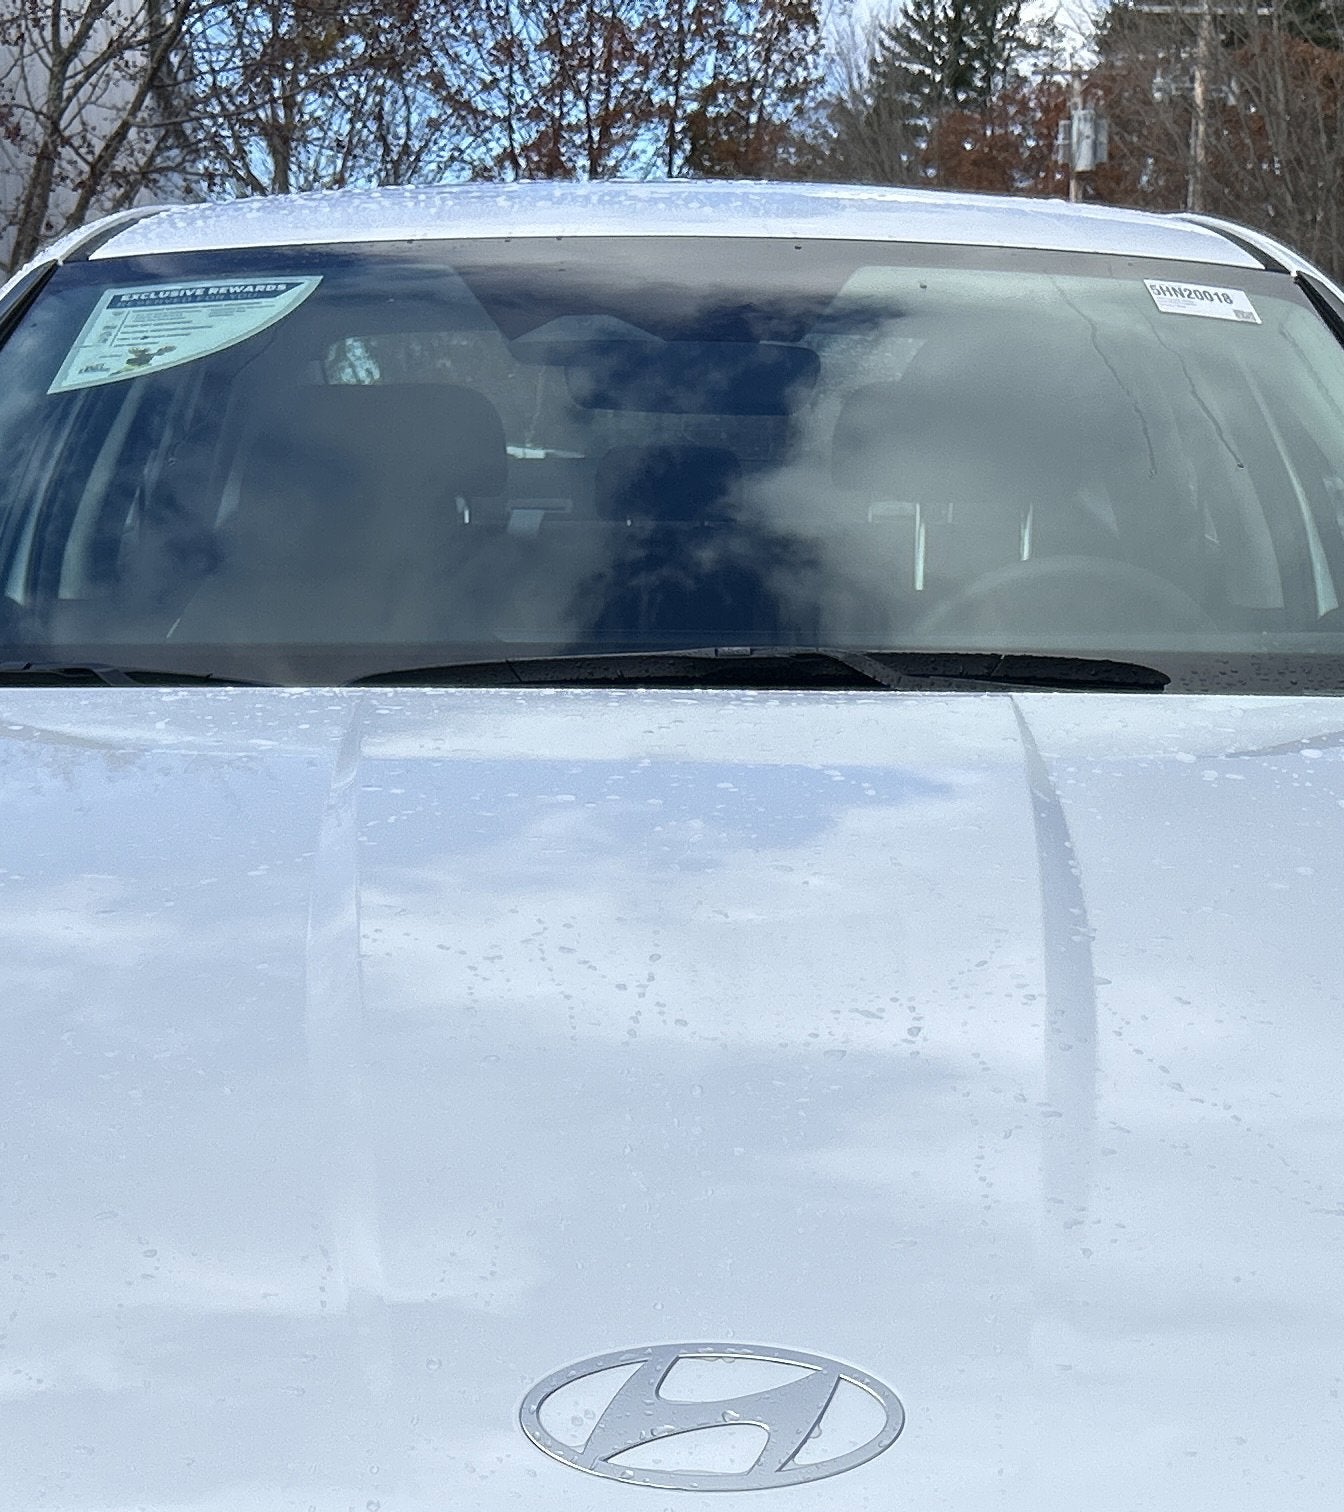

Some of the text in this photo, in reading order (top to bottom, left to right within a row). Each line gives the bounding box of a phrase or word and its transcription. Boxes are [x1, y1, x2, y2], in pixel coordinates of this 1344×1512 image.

[120, 283, 287, 301] EXCLUSIVE REWARDS
[1150, 284, 1233, 304] 5HN20018
